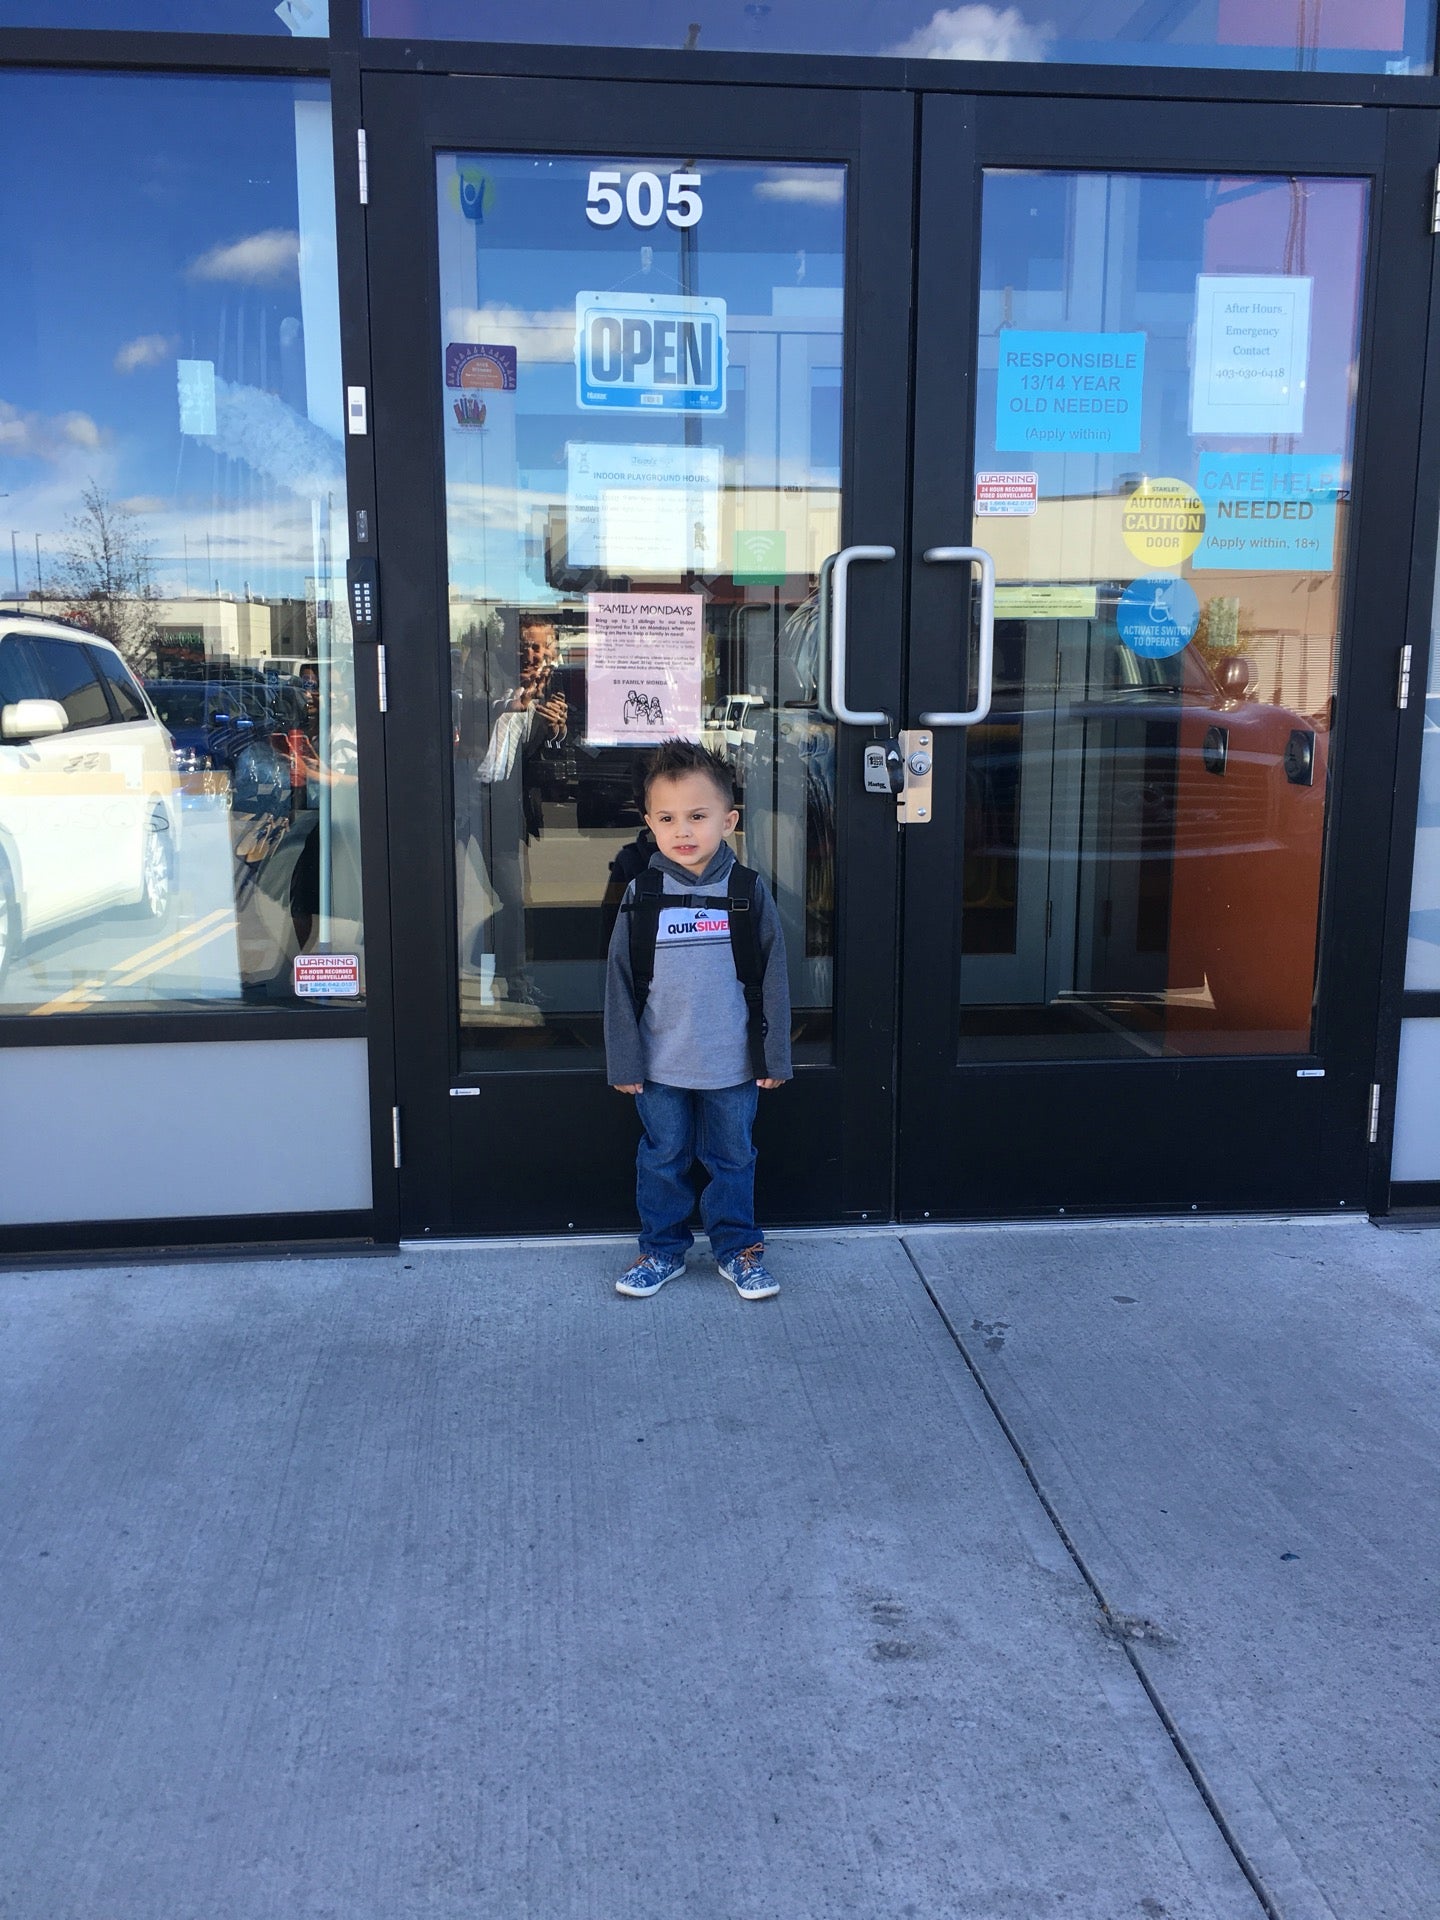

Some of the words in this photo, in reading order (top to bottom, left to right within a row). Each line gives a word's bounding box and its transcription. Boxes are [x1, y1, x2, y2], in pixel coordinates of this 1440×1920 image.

[585, 171, 703, 227] 505
[1224, 303, 1250, 314] After
[1226, 326, 1280, 338] Emergency
[591, 316, 712, 386] OPEN
[1232, 346, 1271, 356] Contact
[1006, 352, 1137, 368] RESPONSIBLE
[1216, 368, 1285, 379] 403-630-6418
[1020, 374, 1066, 390] 13/14
[1071, 376, 1121, 391] YEAR
[1010, 398, 1048, 413] OLD
[1054, 398, 1129, 414] NEEDED
[1025, 428, 1066, 442] (Apply
[1070, 428, 1112, 442] within)
[593, 472, 626, 480] INDOOR
[627, 473, 681, 482] PLAYGROUND
[980, 476, 1034, 484] WARNING
[1203, 468, 1265, 491] CAFÉ
[1273, 472, 1334, 492] HELP
[1130, 497, 1200, 509] AUTOMATIC
[1218, 500, 1314, 520] NEEDED
[1125, 514, 1201, 531] CAUTION
[1146, 537, 1180, 548] DOOR
[1206, 536, 1246, 550] (Apply
[1250, 537, 1290, 549] within,
[1295, 538, 1320, 551] 18+)
[598, 604, 638, 615] FAMILY
[640, 605, 693, 616] MONDAYS
[1124, 626, 1160, 635] ACTIVATE
[1161, 626, 1191, 636] SWITCH
[1134, 636, 1144, 646] TO
[1146, 637, 1180, 647] OPERATE
